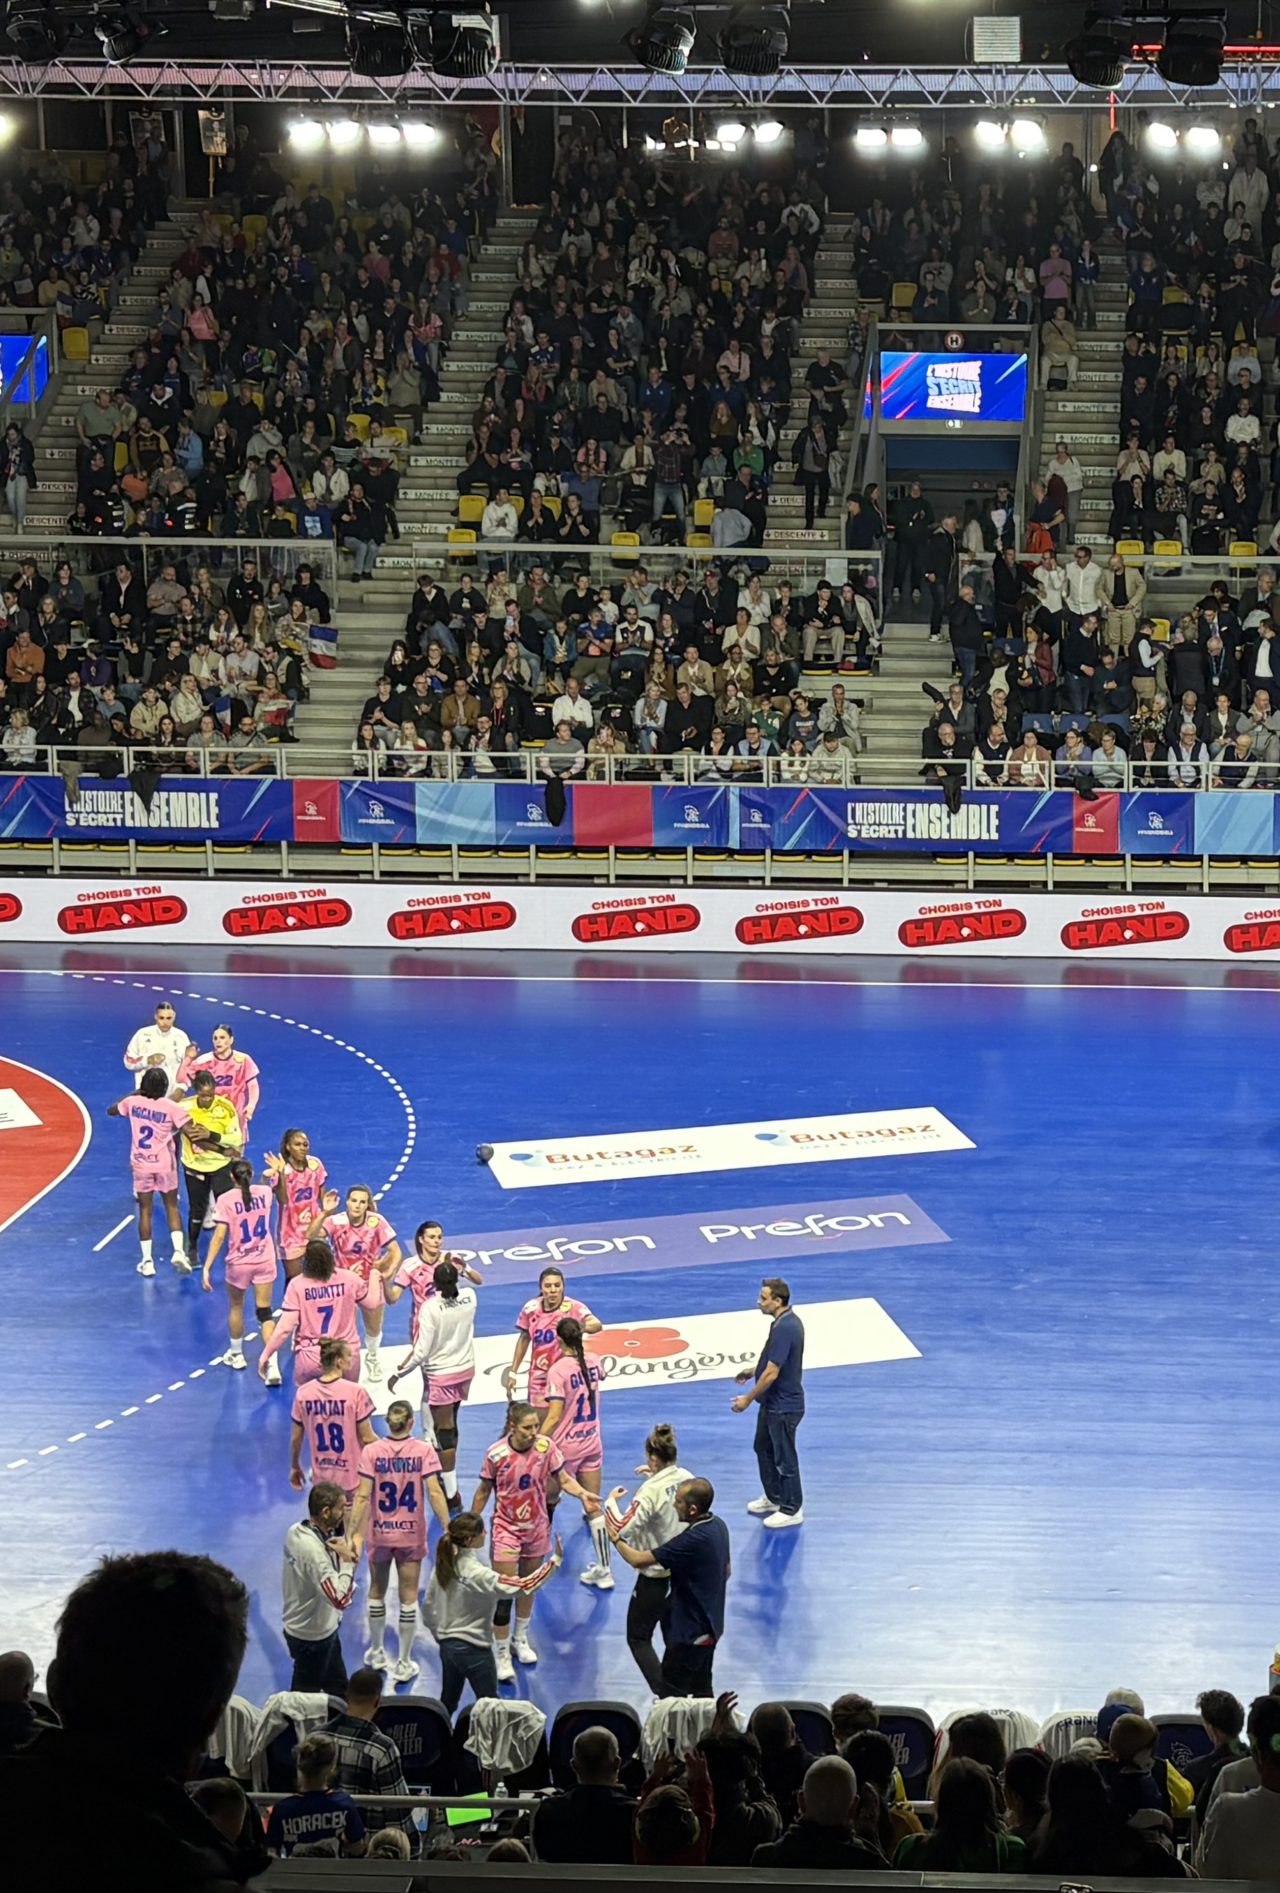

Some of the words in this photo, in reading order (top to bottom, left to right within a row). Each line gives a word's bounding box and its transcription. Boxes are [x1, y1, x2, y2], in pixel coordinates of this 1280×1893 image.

[774, 531, 816, 539] DESCENTE
[65, 791, 123, 813] LISTOIRE
[124, 791, 219, 828] ENSEMBLE
[847, 802, 905, 825] L'HISTOIRE
[847, 824, 905, 838] S'ÉCRIT
[906, 803, 999, 840] ENSEMBLE
[77, 889, 132, 902] CHOISIS
[134, 886, 162, 897] TON
[241, 892, 298, 905] CHOISIS
[299, 889, 326, 900] TON
[406, 895, 462, 910] CHOISIS
[463, 892, 491, 903] TON
[590, 898, 647, 910] CHOISIS
[648, 895, 676, 905] TON
[754, 900, 811, 912] CHOISIS
[812, 897, 839, 907] TON
[65, 899, 183, 931] HAND
[230, 902, 348, 933] HAND
[917, 903, 973, 916] CHOISIS
[975, 900, 1002, 909] TON
[1079, 905, 1136, 917] CHOISIS
[1137, 902, 1164, 912] TON
[395, 905, 512, 936] HAND
[579, 908, 697, 939] HAND
[743, 910, 860, 941] HAND
[906, 913, 1022, 944] HAND
[1068, 915, 1185, 947] HAND
[138, 1125, 154, 1150] 2
[789, 1122, 936, 1144] Butagaz
[544, 1142, 698, 1165] Butagaz
[239, 1215, 267, 1244] 14
[352, 1240, 363, 1254] 5
[317, 1304, 334, 1335] 7
[533, 1328, 556, 1345] 20
[315, 1421, 345, 1455] 18
[519, 1473, 532, 1491] 6
[379, 1481, 418, 1514] 34
[281, 1810, 349, 1837] HORACEK
